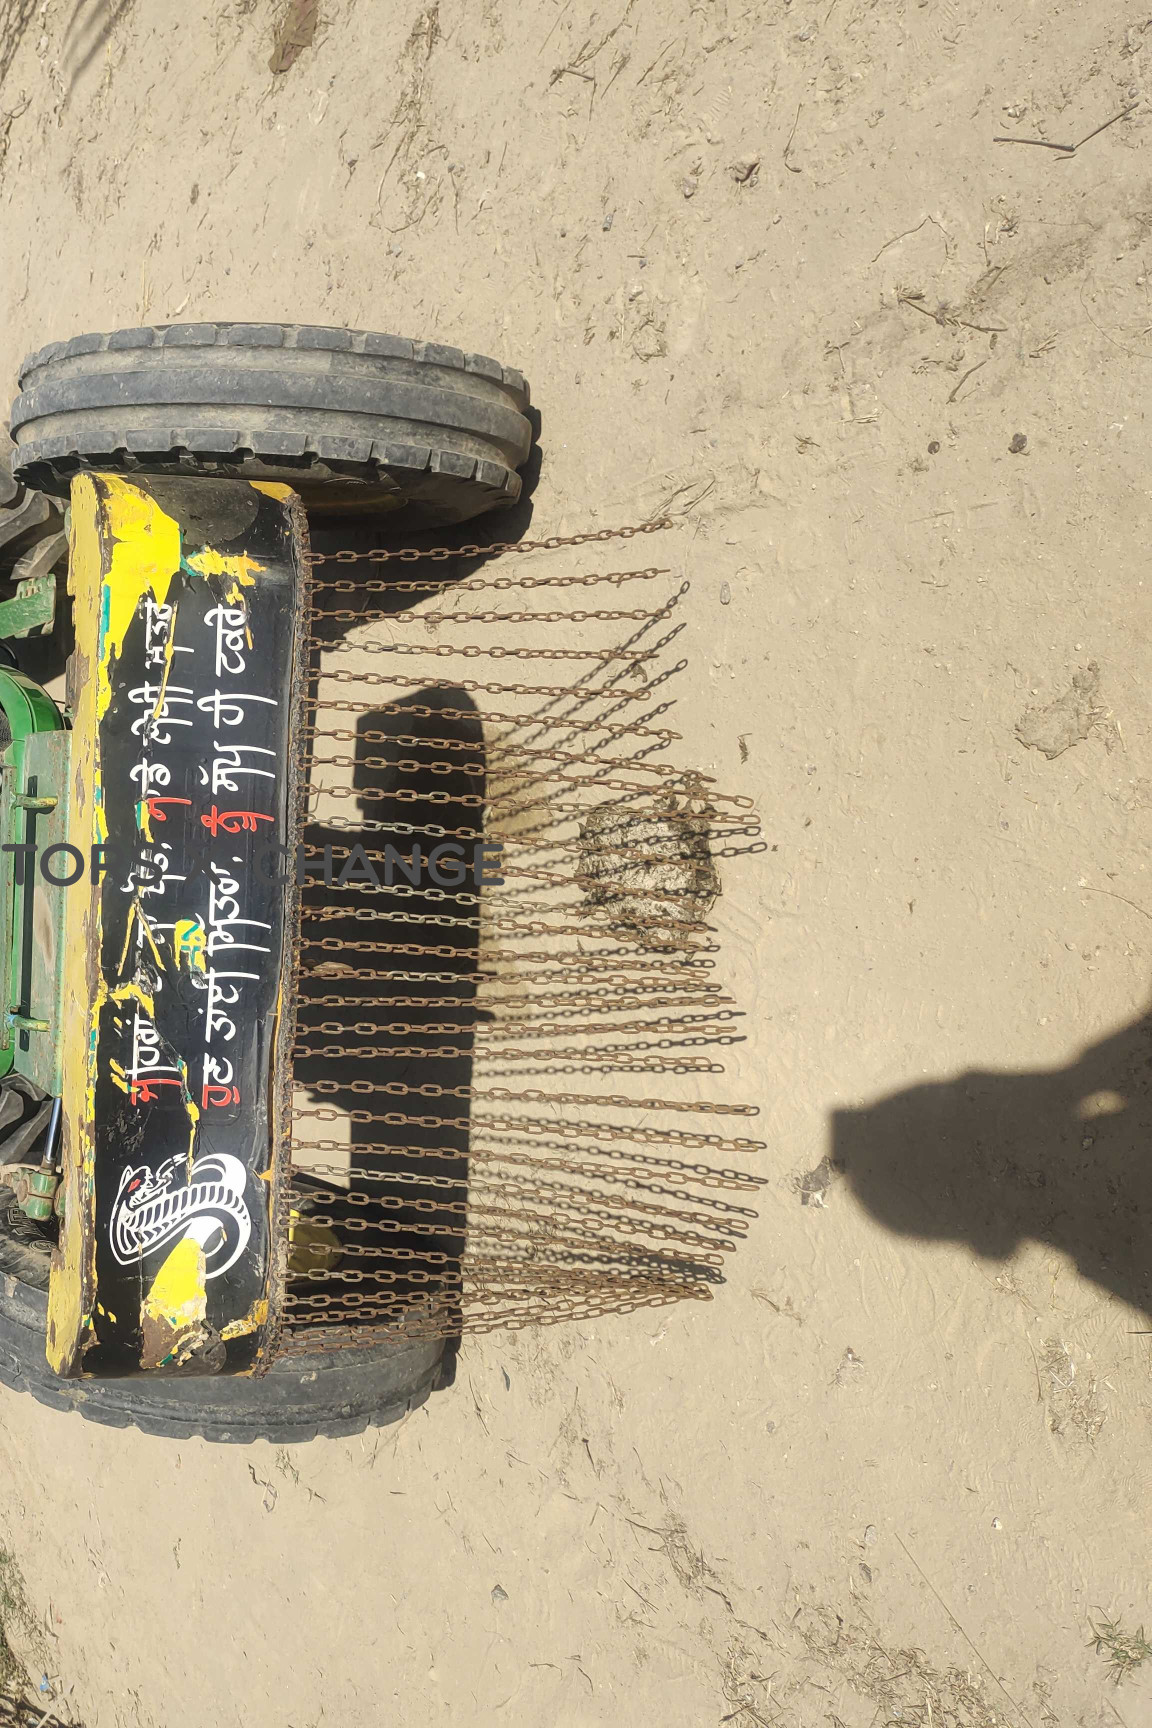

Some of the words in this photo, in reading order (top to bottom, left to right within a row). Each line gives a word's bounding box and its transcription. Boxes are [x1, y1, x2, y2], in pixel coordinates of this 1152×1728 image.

[196, 689, 278, 728] ਹੀ
[198, 741, 276, 795] ਸੱਪ
[201, 805, 275, 837] ਨੂੰ
[201, 1052, 241, 1110] ਹੁਣ
